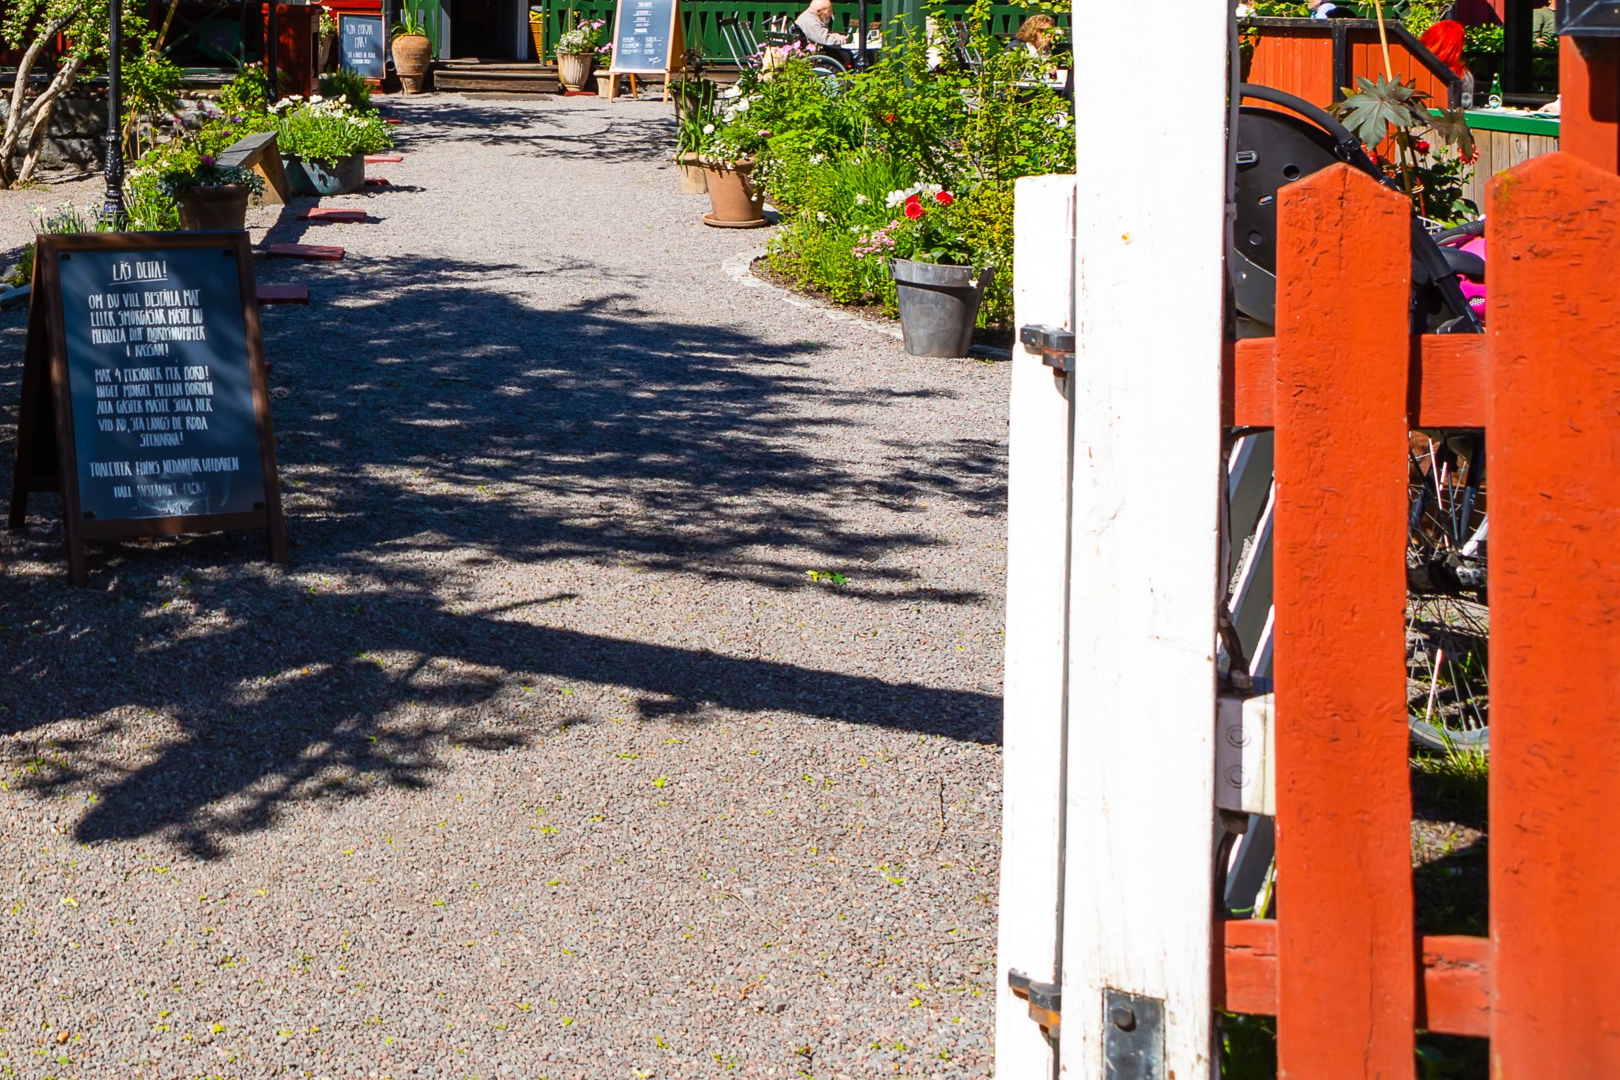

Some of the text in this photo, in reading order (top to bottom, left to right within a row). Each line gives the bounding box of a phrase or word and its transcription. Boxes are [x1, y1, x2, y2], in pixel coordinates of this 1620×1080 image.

[112, 260, 132, 281] LÄS
[88, 289, 200, 309] OM DU VILL BESTÄLLA MAT
[90, 311, 116, 327] ELLER
[192, 308, 203, 324] DU
[91, 325, 206, 345] MEDDELA DITT BORDSNUMMER
[95, 369, 112, 383] MAX
[114, 368, 121, 382] 4
[123, 366, 162, 382] PERSONER
[165, 366, 181, 380] PER
[96, 381, 214, 398] INGET MINGEL MELLAN BORDEN
[96, 400, 114, 415] ALLA
[195, 398, 214, 412] NER
[98, 418, 114, 432] VID
[172, 416, 183, 430] DE
[89, 461, 132, 478] TOALETTER
[135, 459, 160, 475] FINNS
